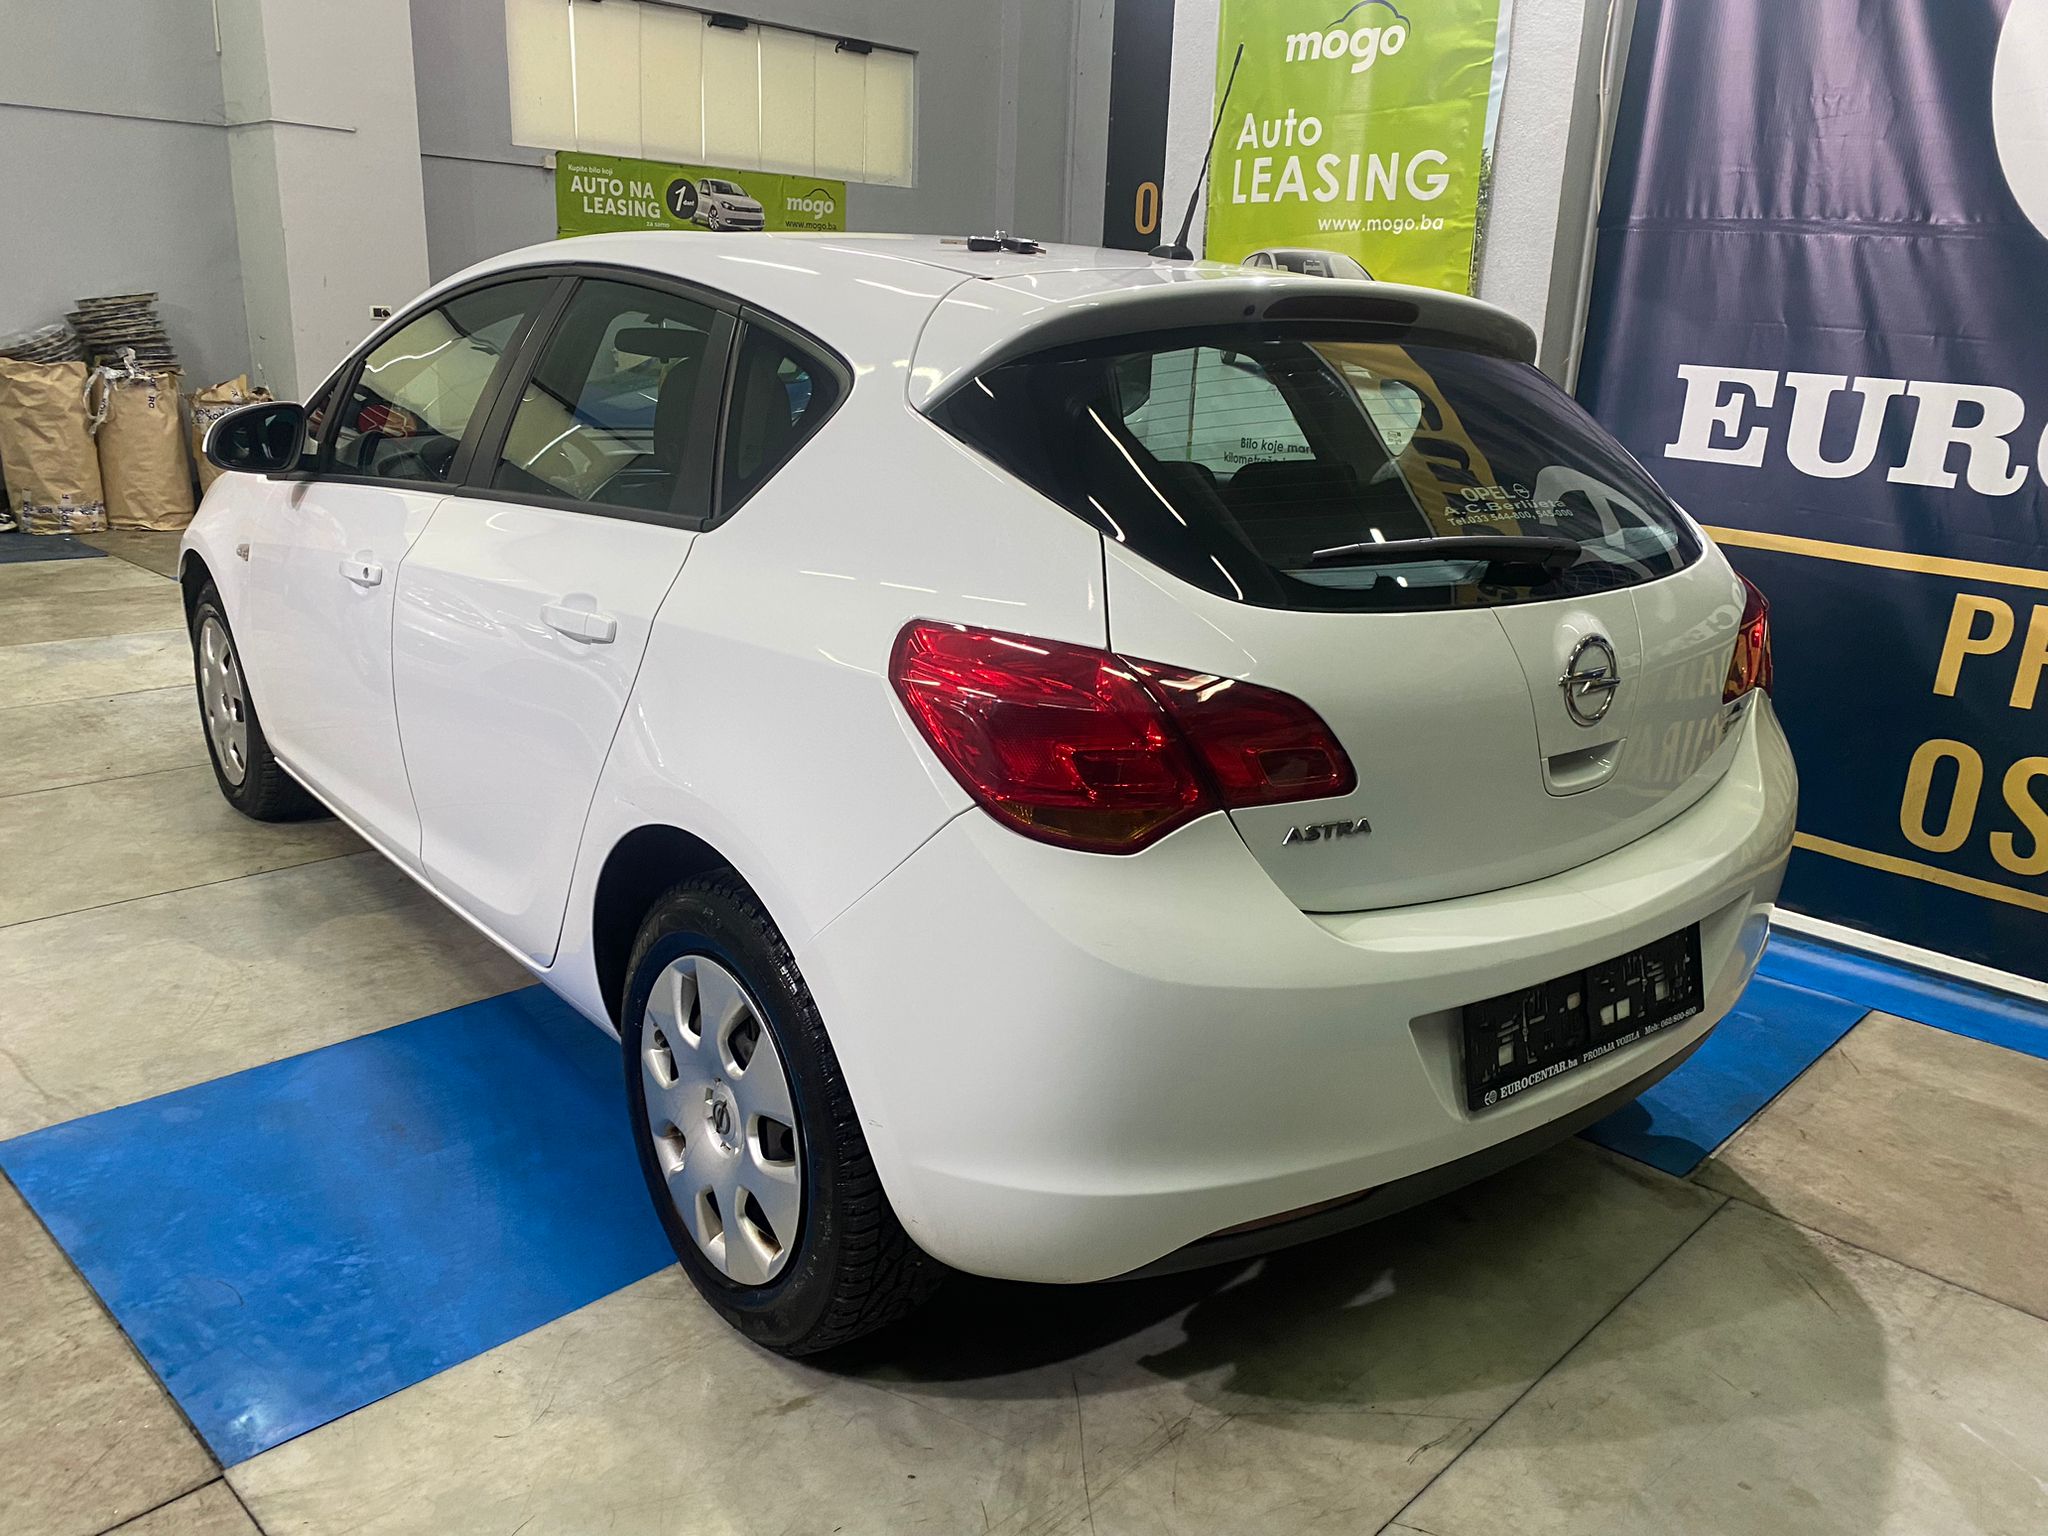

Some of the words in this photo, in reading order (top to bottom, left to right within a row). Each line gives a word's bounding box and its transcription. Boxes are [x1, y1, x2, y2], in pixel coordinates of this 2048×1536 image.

[1285, 24, 1406, 74] mogo
[1236, 108, 1323, 150] Auto
[567, 164, 588, 173] Kupite
[588, 166, 601, 174] bilo
[601, 167, 614, 177] koji
[1232, 150, 1450, 204] LEASING
[570, 175, 624, 196] AUTO
[629, 181, 655, 199] NA
[583, 196, 661, 219] LEASING
[786, 197, 835, 220] mogo
[785, 220, 837, 232] www.mogo.ba
[1318, 213, 1445, 235] www.mogo.ba
[1664, 363, 2048, 497] EUR
[1240, 437, 1258, 449] Bilo
[1261, 440, 1284, 454] koje
[1287, 445, 1314, 454] mar
[1460, 485, 1516, 502] OPEL
[1282, 817, 1372, 846] ASTRA
[1500, 1059, 1578, 1099] EUROCENTAR.ba
[1583, 1041, 1616, 1062] PRODAJA
[1616, 1031, 1640, 1047] VOZILA
